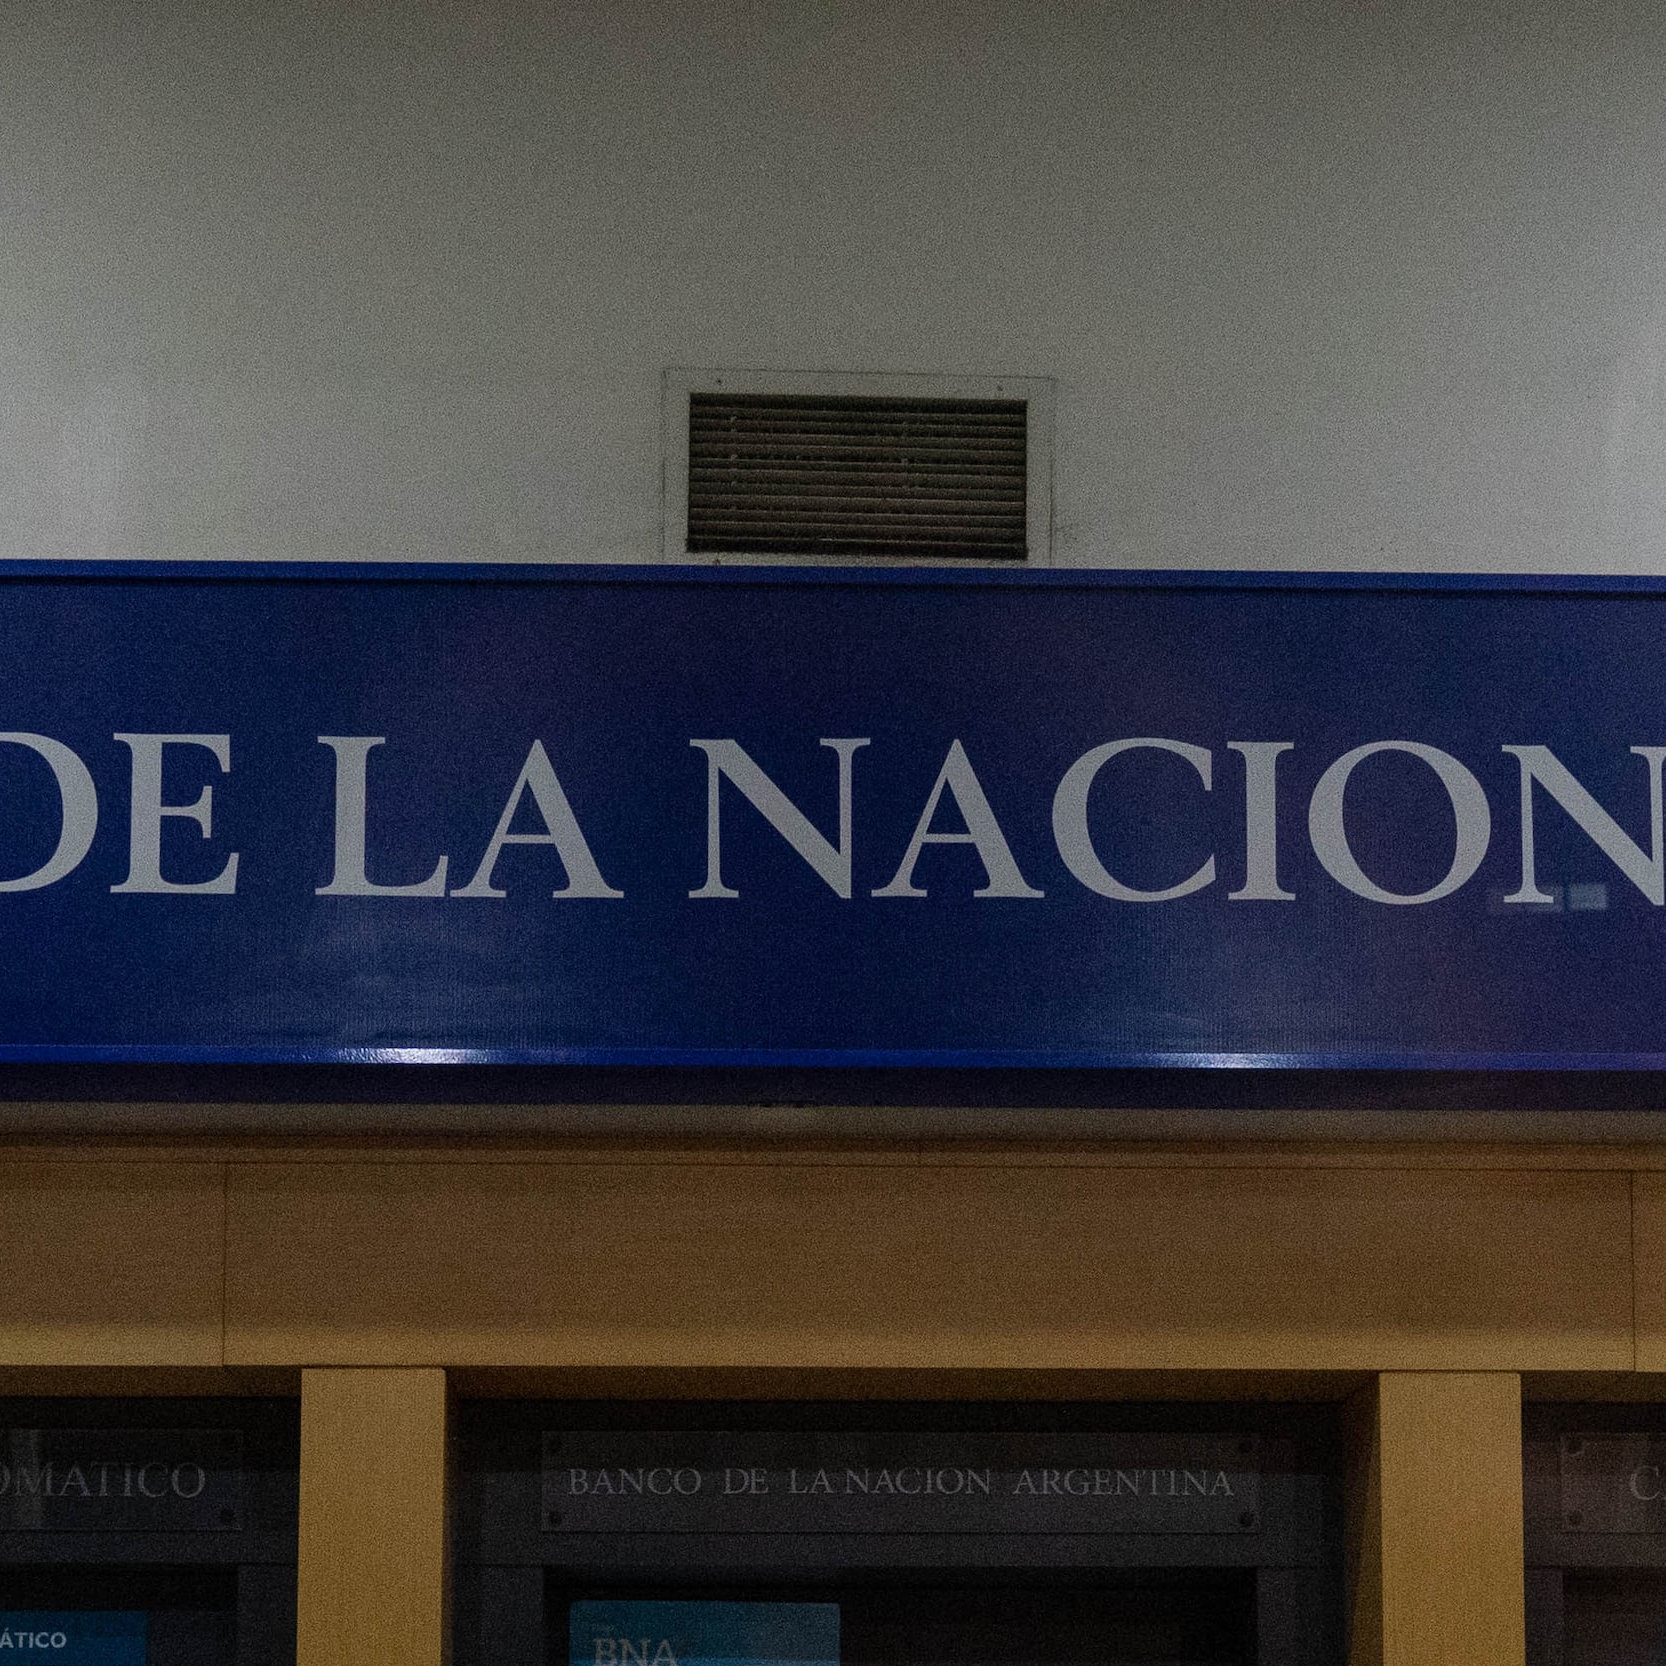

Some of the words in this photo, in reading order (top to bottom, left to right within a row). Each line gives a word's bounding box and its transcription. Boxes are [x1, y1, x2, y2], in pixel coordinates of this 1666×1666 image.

[316, 737, 623, 897] LA
[568, 1467, 703, 1497] BANCO
[723, 1468, 769, 1496] DE
[787, 1468, 835, 1496] LA
[844, 1468, 993, 1497] NACION
[1012, 1468, 1235, 1497] ARGENTINA
